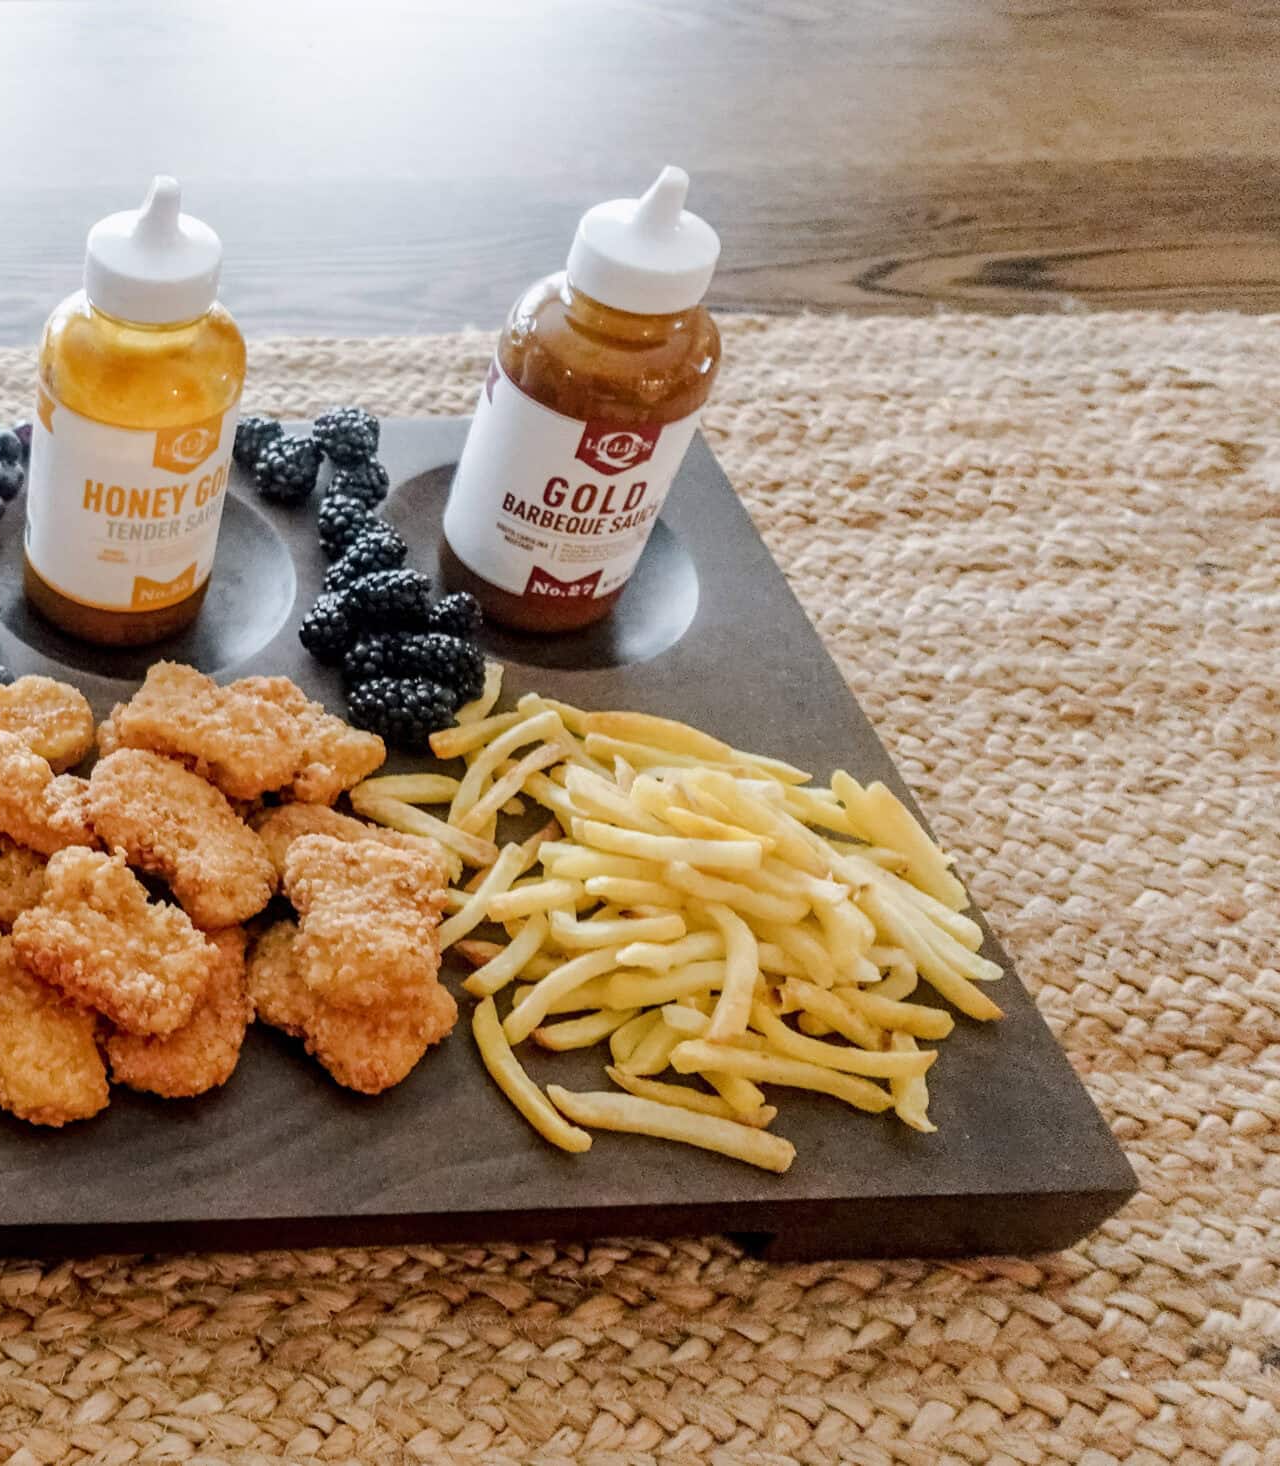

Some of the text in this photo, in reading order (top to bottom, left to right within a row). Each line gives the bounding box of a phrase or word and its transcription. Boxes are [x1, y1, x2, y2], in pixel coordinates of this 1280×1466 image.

[82, 457, 229, 520] HONEY GO
[542, 476, 648, 515] GOLD
[106, 520, 181, 541] TENDER
[501, 492, 606, 536] BARBEQUE
[530, 580, 595, 598] No.27
